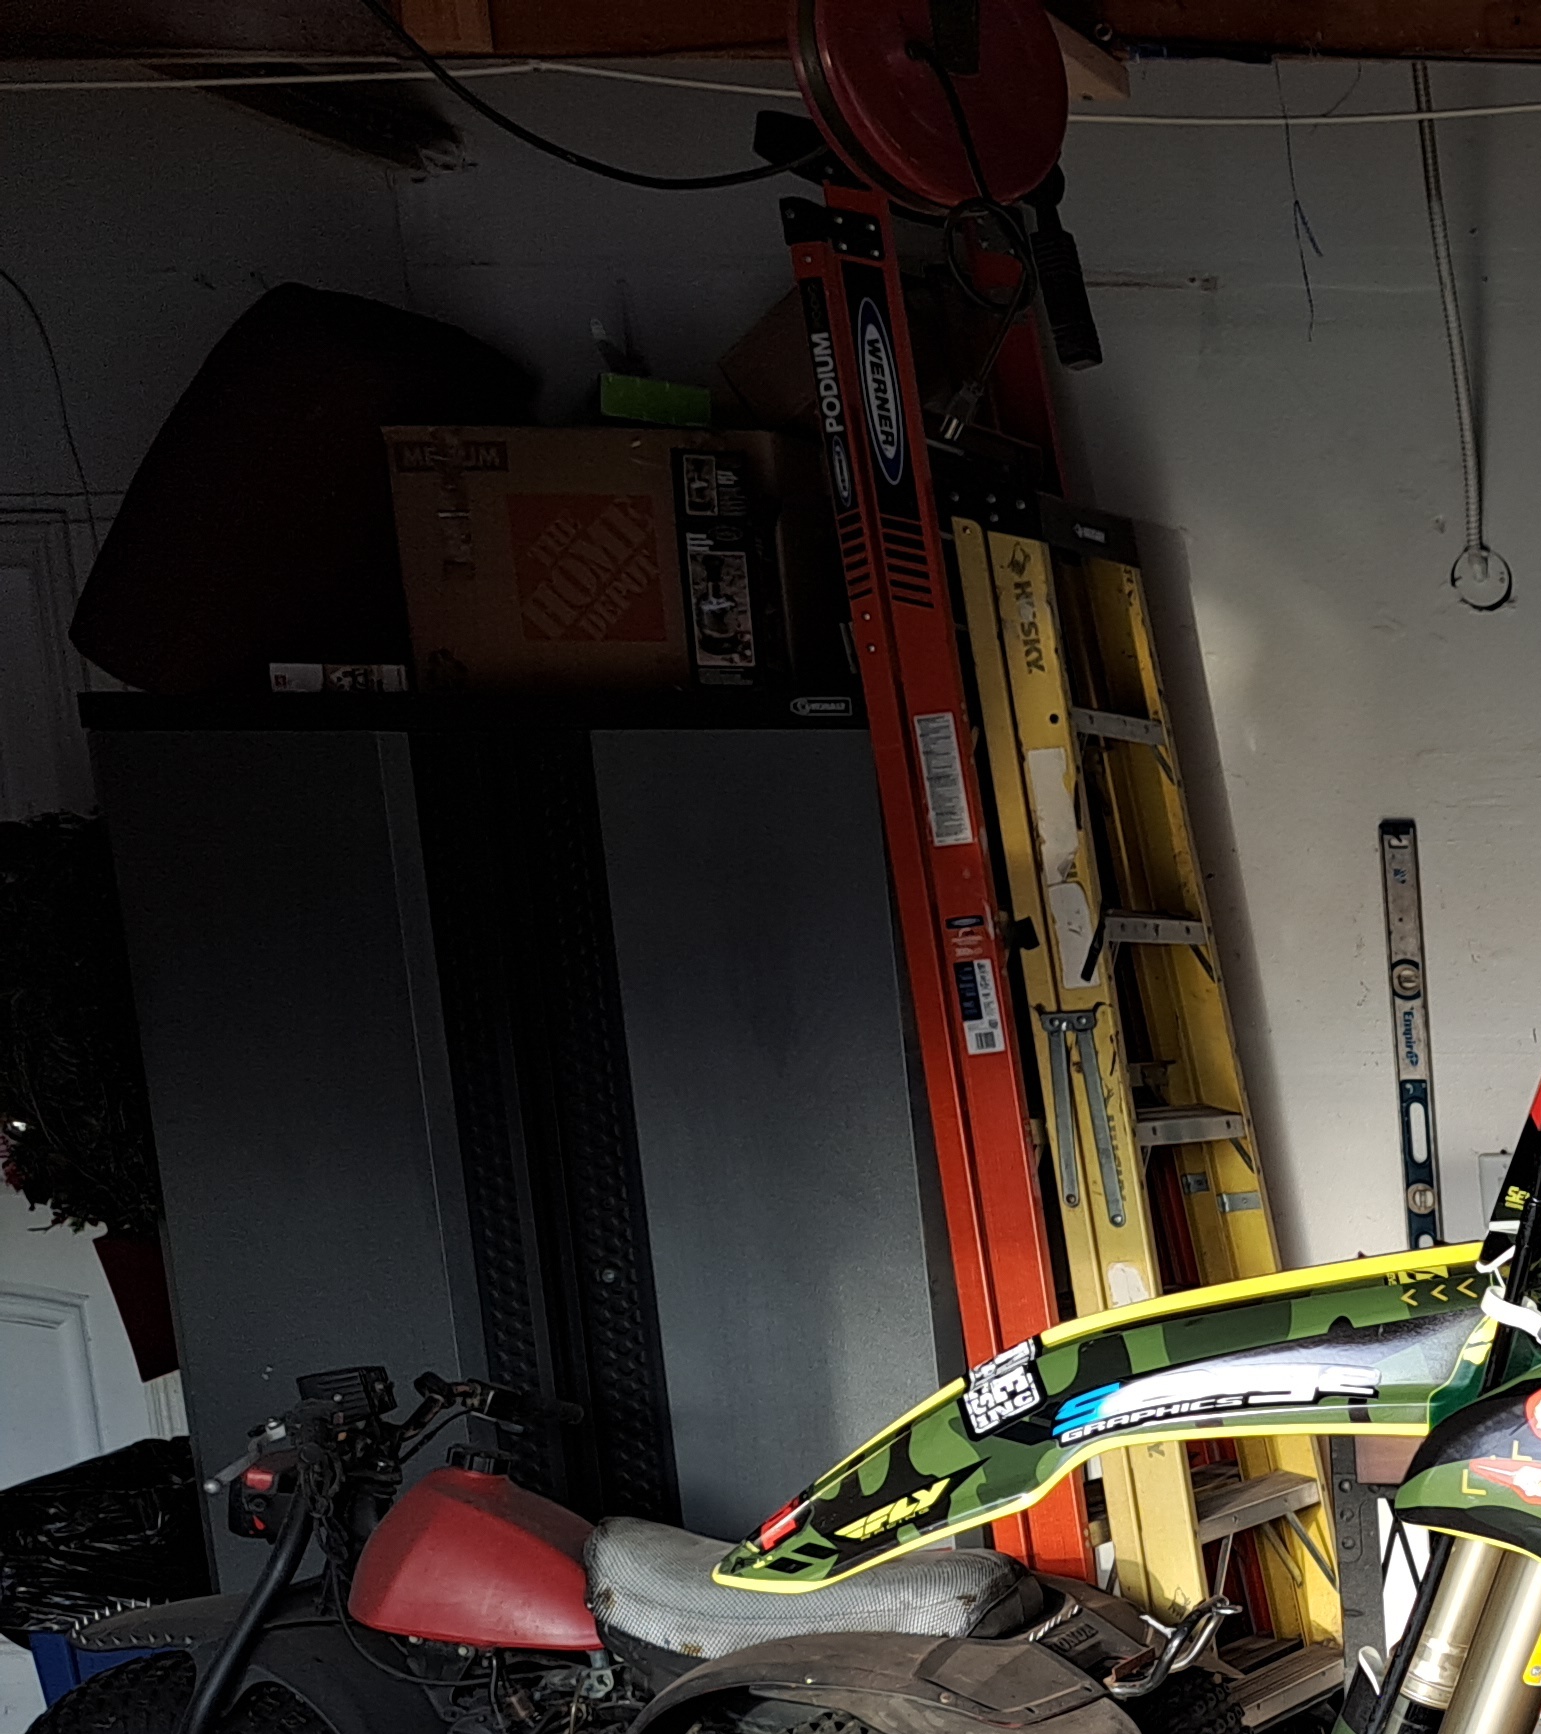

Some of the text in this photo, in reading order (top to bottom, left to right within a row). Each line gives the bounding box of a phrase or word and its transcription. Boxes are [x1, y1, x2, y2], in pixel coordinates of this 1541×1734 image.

[811, 332, 844, 433] PODIUM
[866, 338, 896, 452] WERNER
[1014, 580, 1046, 674] HSKY
[1061, 1395, 1243, 1443] GRAPHICS
[834, 1477, 950, 1539] FLY
